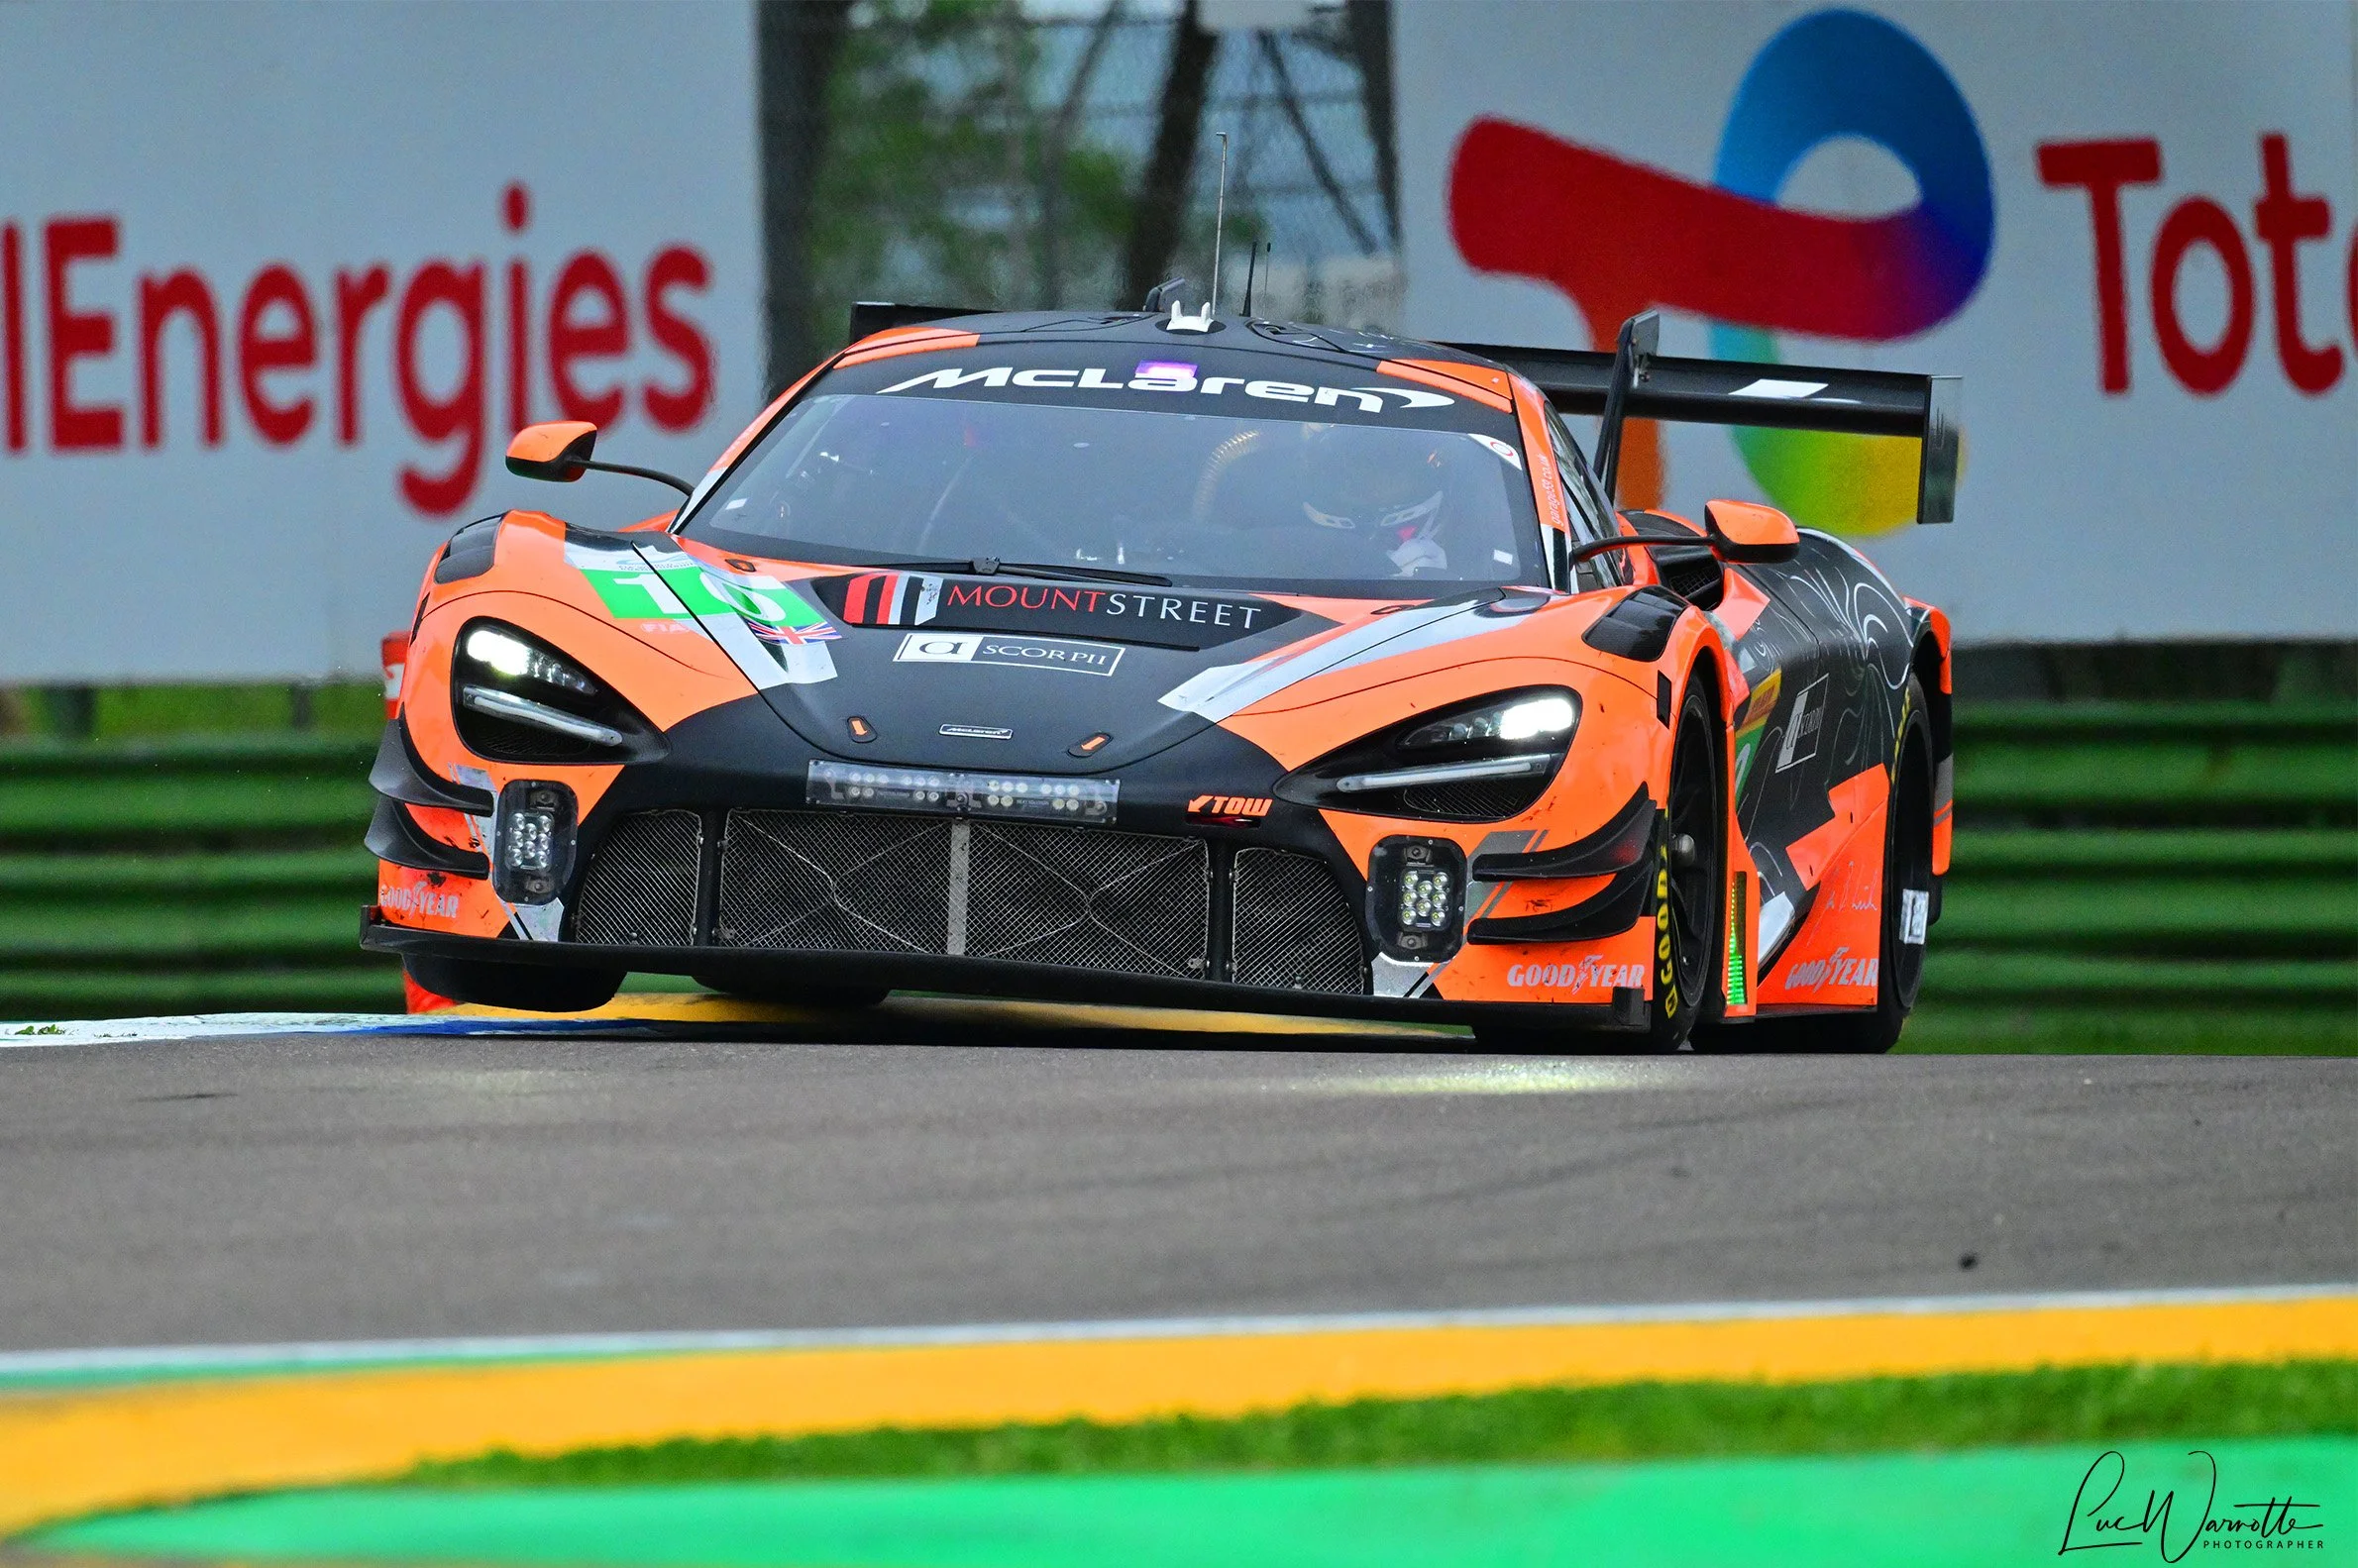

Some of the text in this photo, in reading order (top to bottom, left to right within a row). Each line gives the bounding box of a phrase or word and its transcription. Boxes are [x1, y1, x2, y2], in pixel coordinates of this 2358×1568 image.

[2034, 131, 2358, 396] Tot
[876, 366, 1383, 414] McLaren
[982, 644, 1108, 667] SCORPII
[1211, 795, 1274, 817] TOW
[379, 882, 459, 919] GOODYEAR
[1506, 960, 1646, 991] GOODYEAR
[1784, 953, 1878, 992] GOODYEAR
